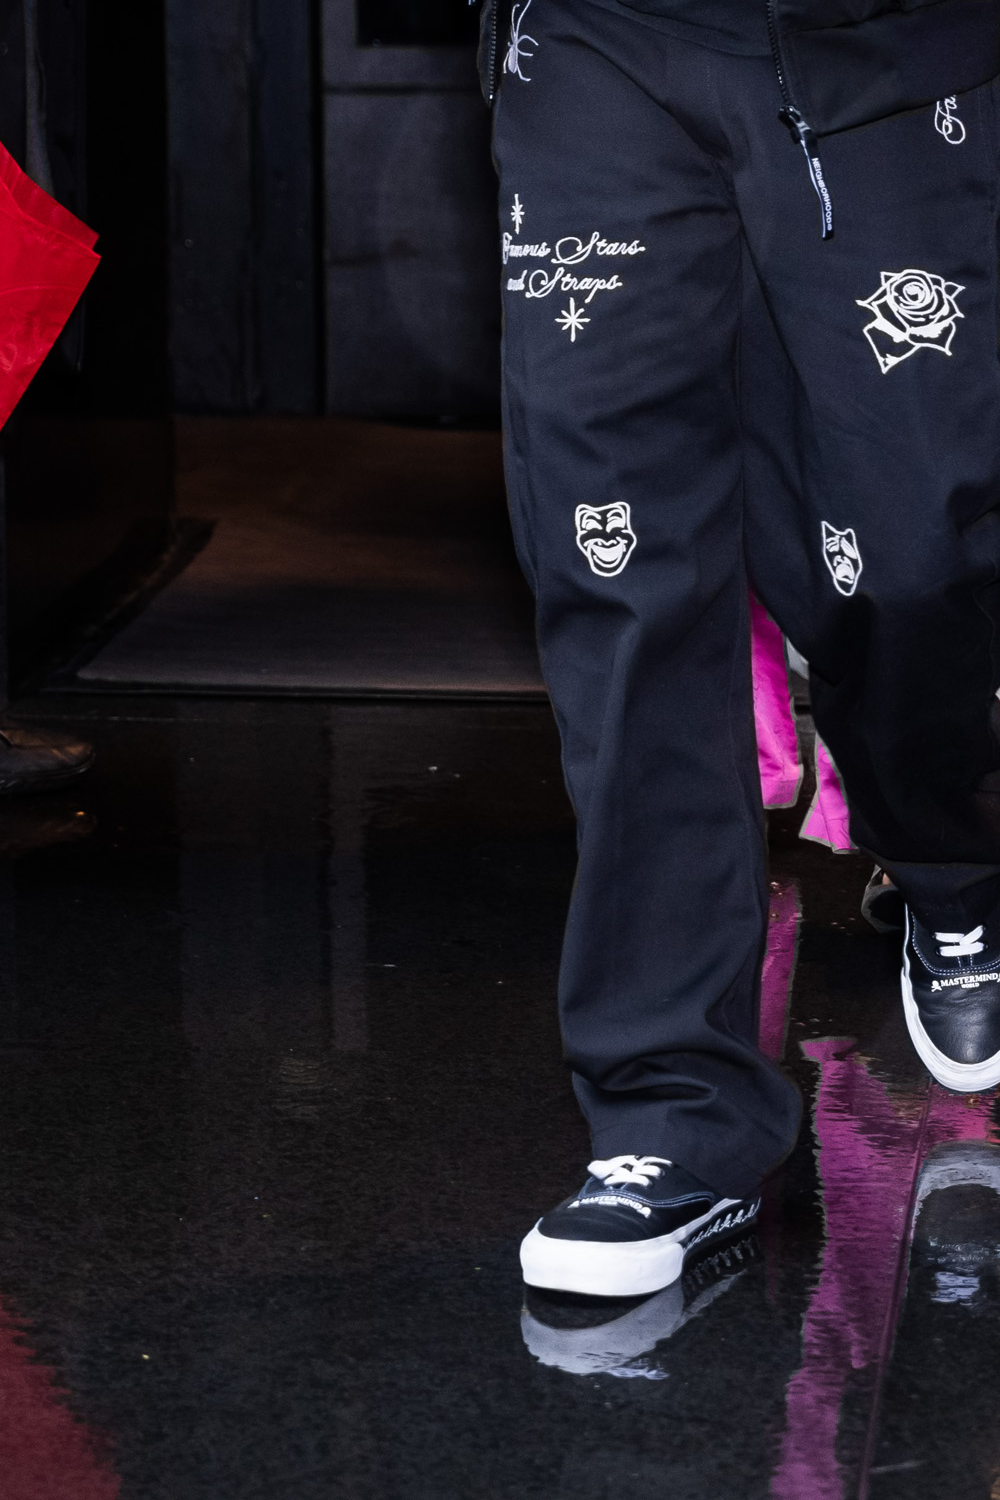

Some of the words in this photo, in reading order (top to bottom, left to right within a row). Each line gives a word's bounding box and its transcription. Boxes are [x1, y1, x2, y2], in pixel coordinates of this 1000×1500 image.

[811, 157, 832, 225] NEIGHBORHOOD
[551, 232, 645, 264] Stars
[525, 267, 623, 303] Straps
[940, 972, 999, 987] MASTERMIND
